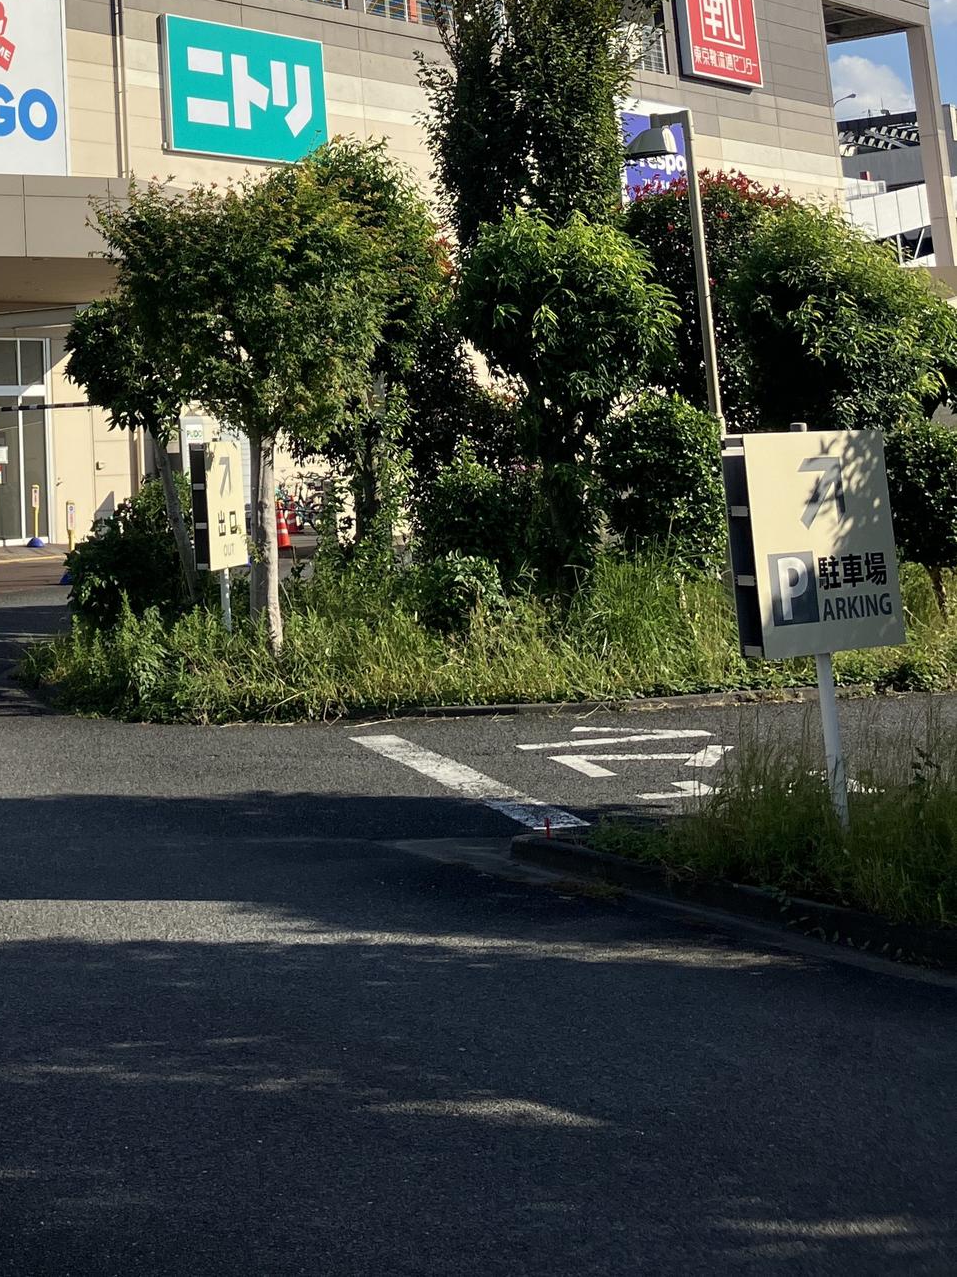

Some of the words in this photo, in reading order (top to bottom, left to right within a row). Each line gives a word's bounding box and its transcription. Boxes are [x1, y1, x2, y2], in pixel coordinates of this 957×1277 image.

[187, 46, 313, 138] ニトリ
[223, 542, 236, 557] OUT
[817, 552, 887, 591] 駐車場
[823, 592, 892, 622] ARKING
